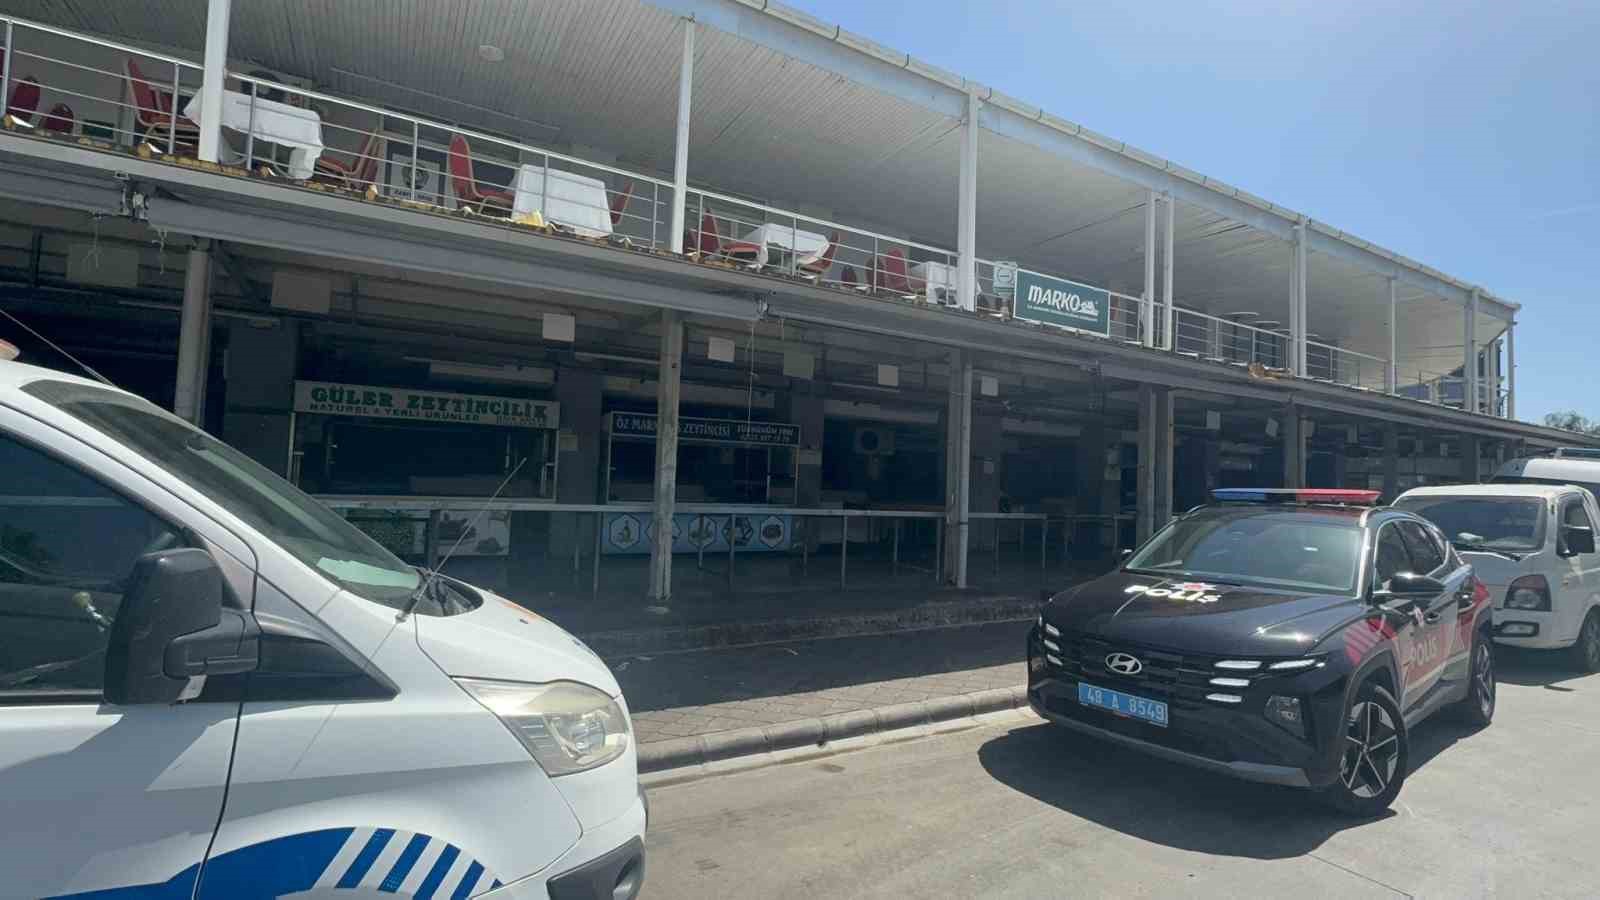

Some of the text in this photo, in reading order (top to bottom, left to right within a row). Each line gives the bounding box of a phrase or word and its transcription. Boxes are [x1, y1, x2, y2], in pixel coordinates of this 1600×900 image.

[1028, 284, 1081, 312] MARKO
[311, 385, 546, 416] GÜLER ZEYTİNCİLİK
[616, 415, 631, 431] ÖZ
[1087, 687, 1165, 721] 48 A 8549
